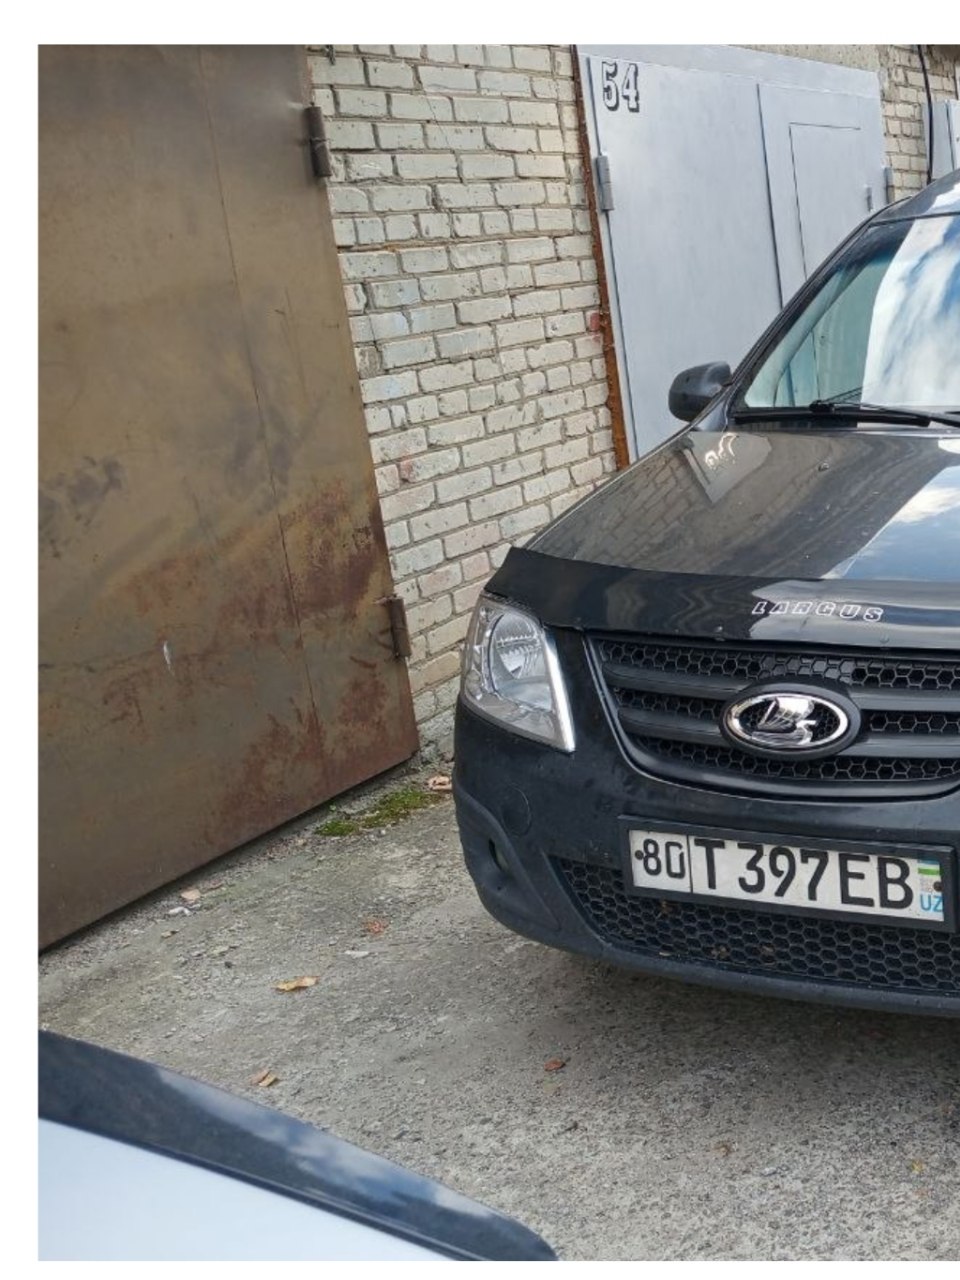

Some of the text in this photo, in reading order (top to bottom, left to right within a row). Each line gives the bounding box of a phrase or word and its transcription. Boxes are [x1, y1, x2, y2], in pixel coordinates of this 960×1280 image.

[602, 61, 640, 113] 54
[752, 601, 884, 622] LARGUS
[642, 838, 686, 880] 80
[920, 893, 945, 913] UZ
